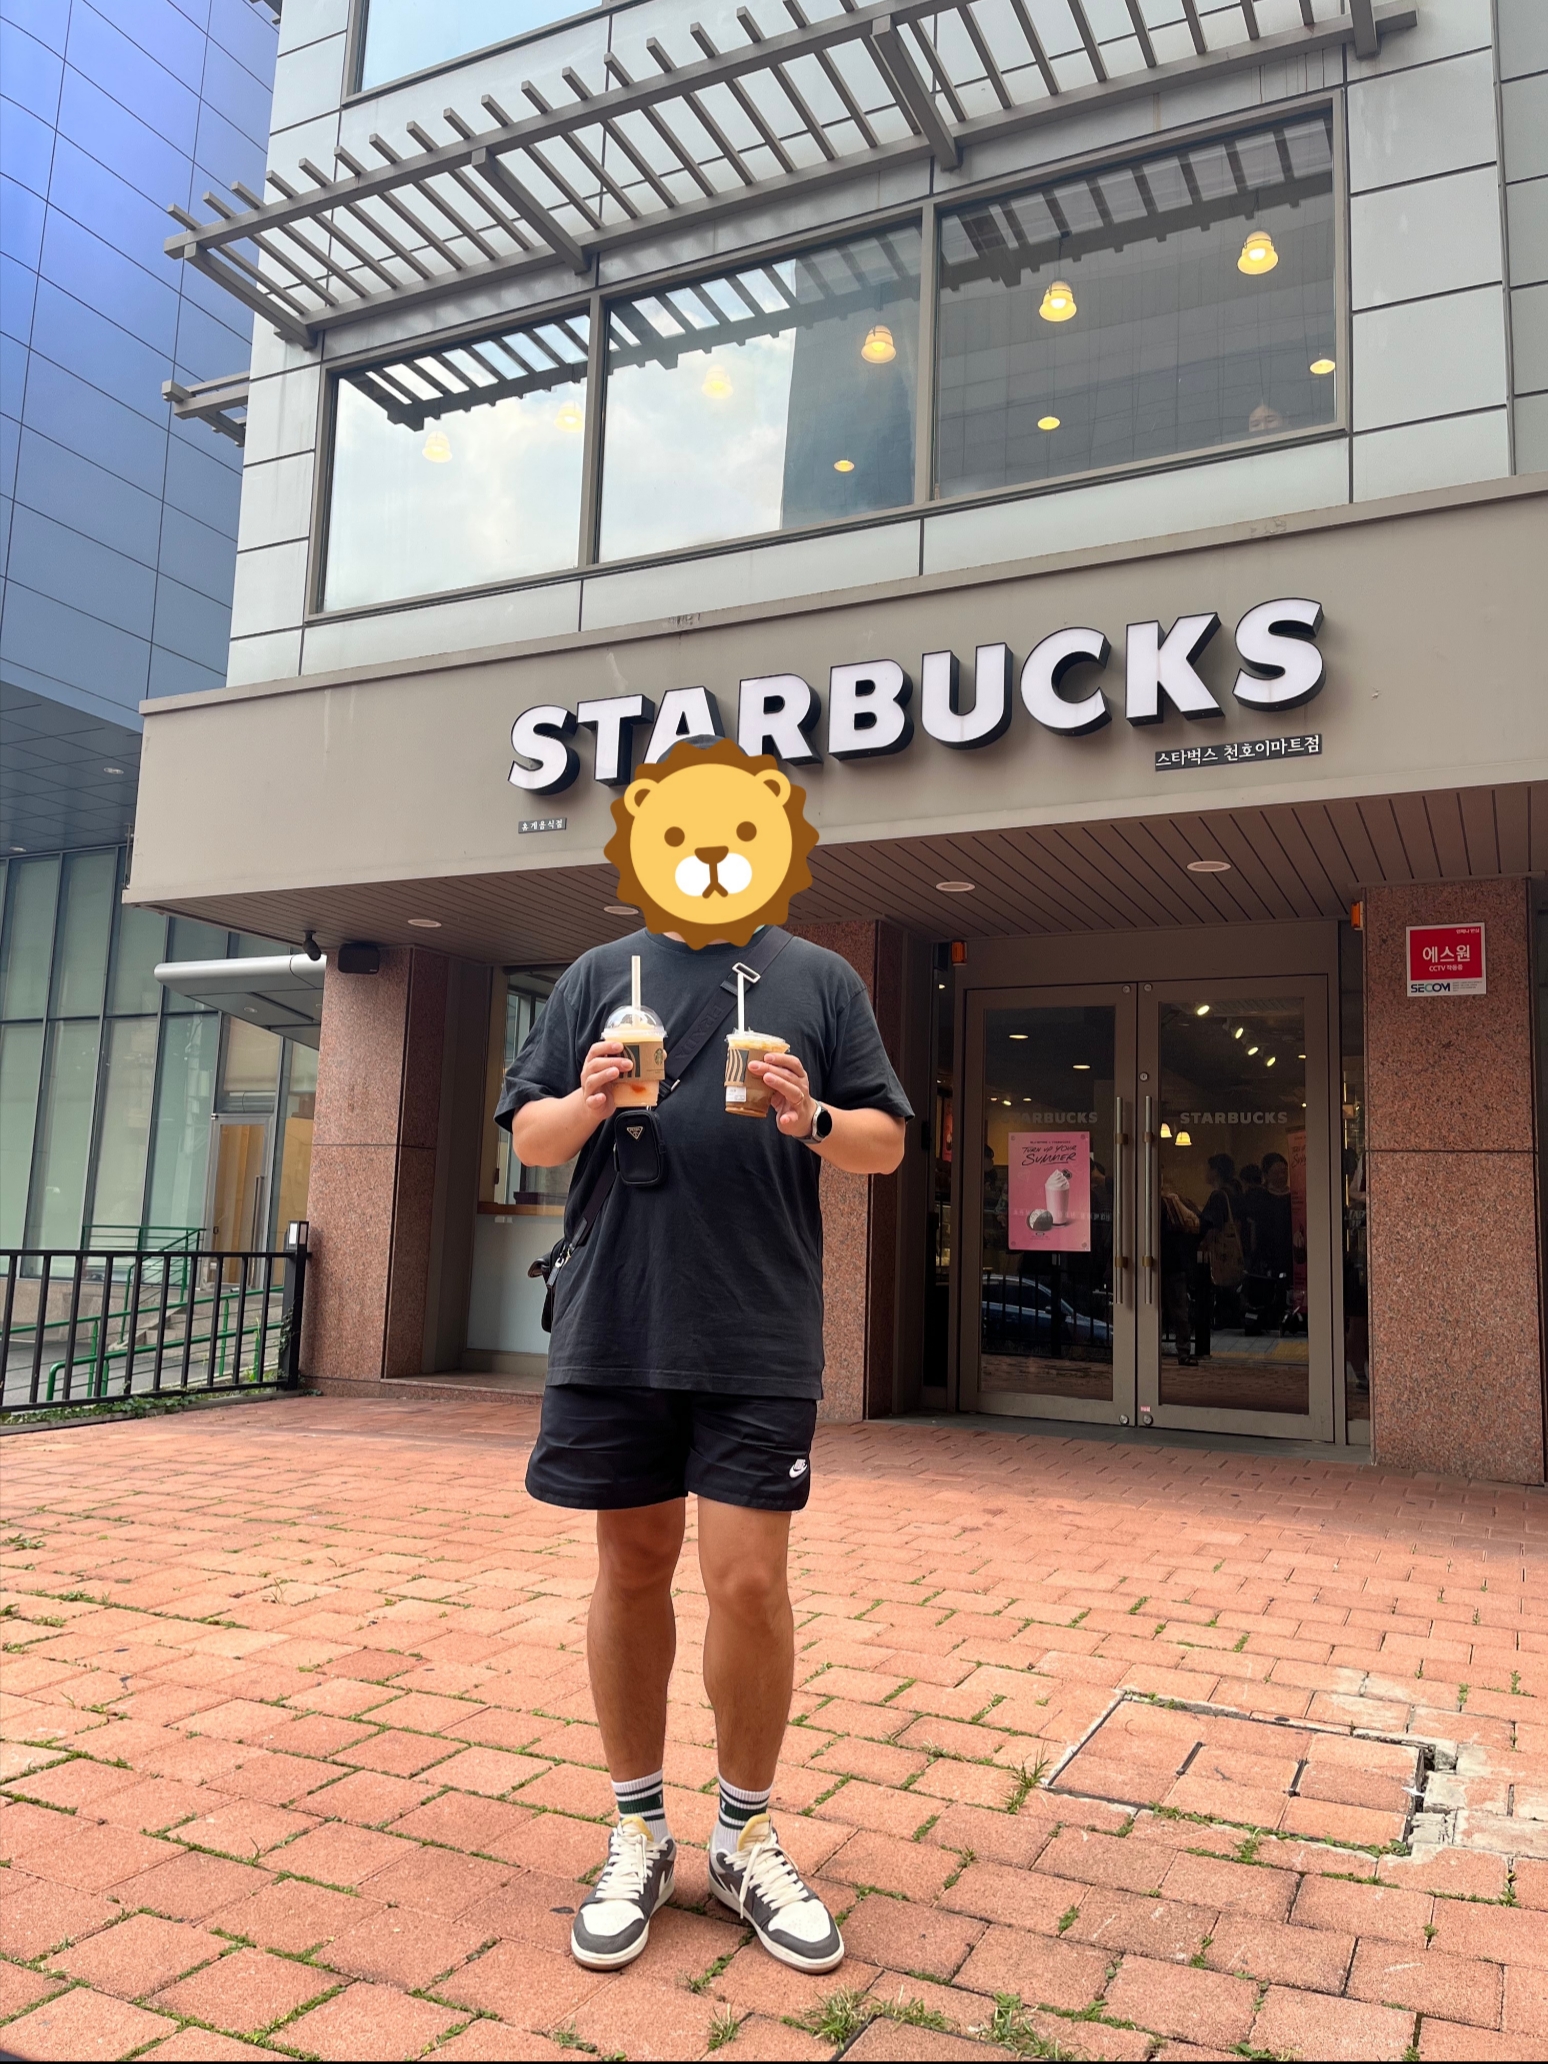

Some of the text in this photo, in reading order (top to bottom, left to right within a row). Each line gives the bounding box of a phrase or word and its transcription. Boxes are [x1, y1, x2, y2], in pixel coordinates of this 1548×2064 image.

[508, 597, 1325, 795] STARBUCKS
[1155, 734, 1320, 766] 스타벅스 천호이마트점
[521, 818, 563, 832] 휴게음식점
[1422, 944, 1471, 963] 에스원
[1410, 983, 1451, 994] SECOM
[674, 1003, 725, 1059] PRADA
[1180, 1111, 1288, 1124] STARBUCKS
[1022, 1152, 1077, 1166] SUMMER
